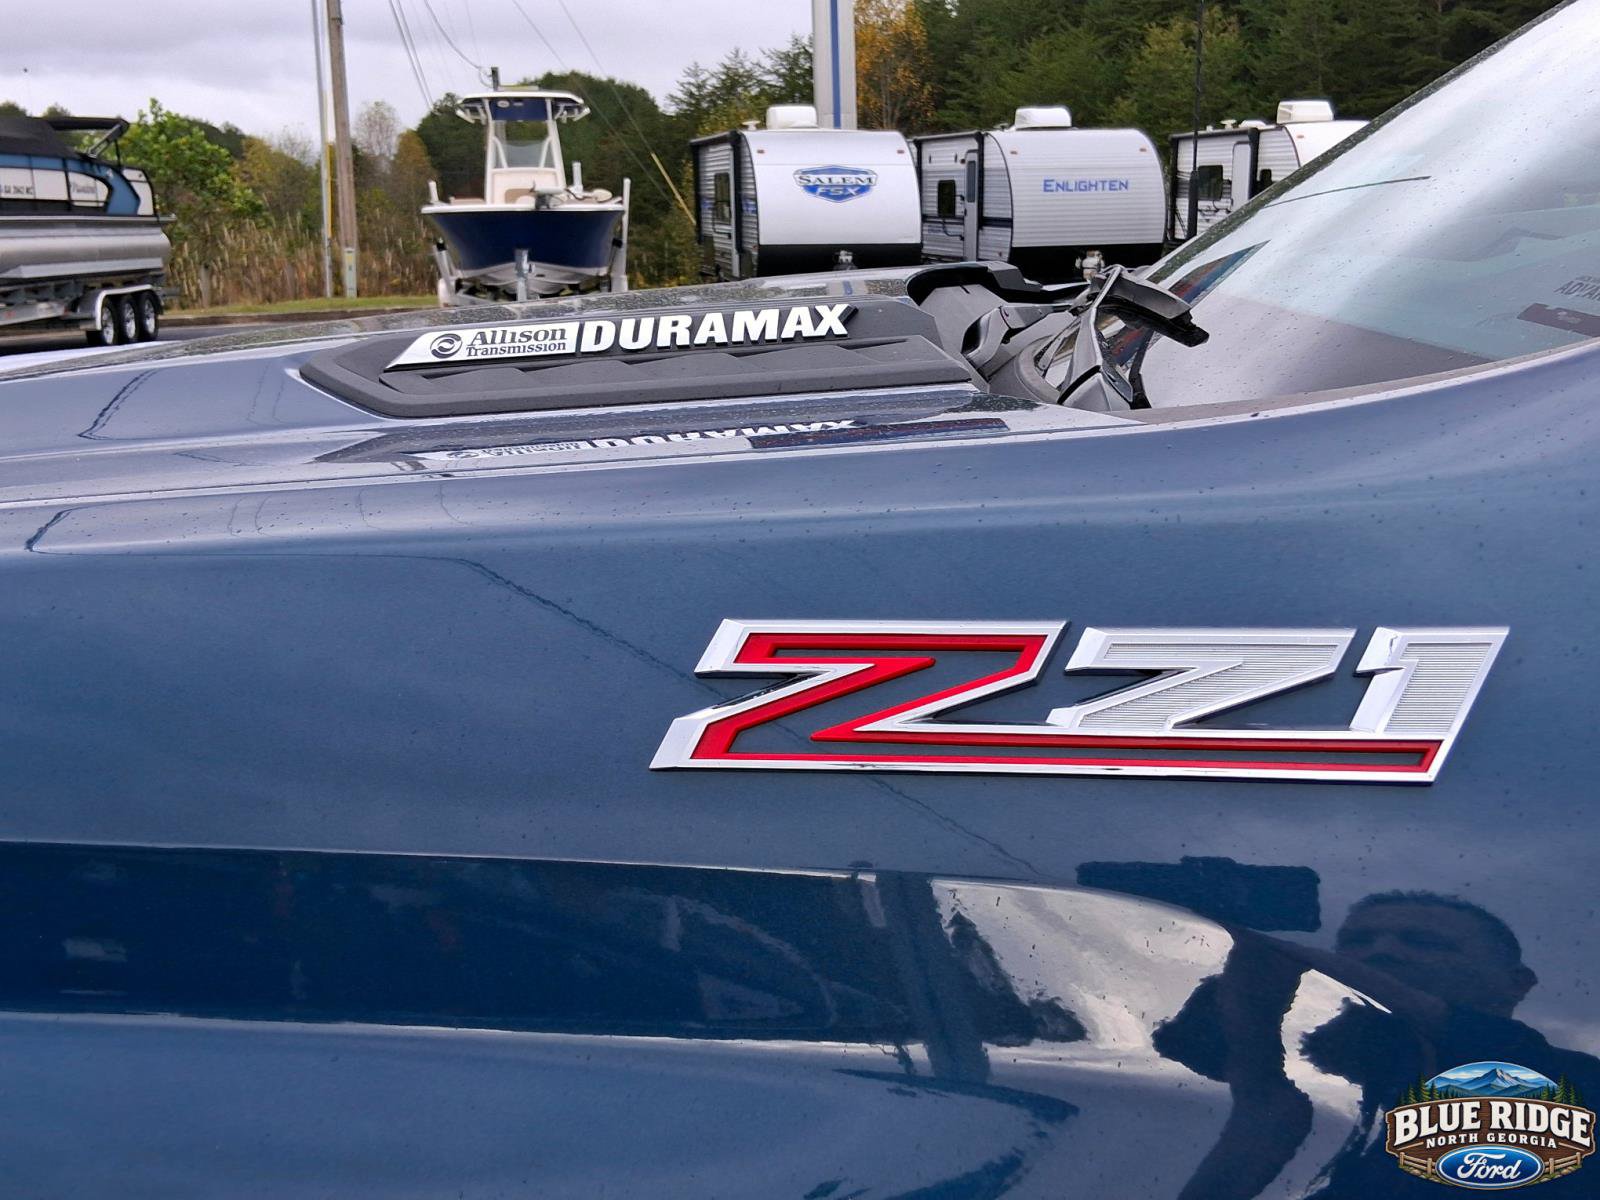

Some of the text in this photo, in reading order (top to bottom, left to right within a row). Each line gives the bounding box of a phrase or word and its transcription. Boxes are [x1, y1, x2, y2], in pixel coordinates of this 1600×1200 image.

[798, 175, 874, 184] SALEM
[1043, 179, 1129, 192] ENLIGHTEN
[580, 303, 855, 353] DURAMAX
[467, 328, 567, 346] Allison
[466, 342, 566, 357] Transmission
[650, 618, 1510, 785] Z71
